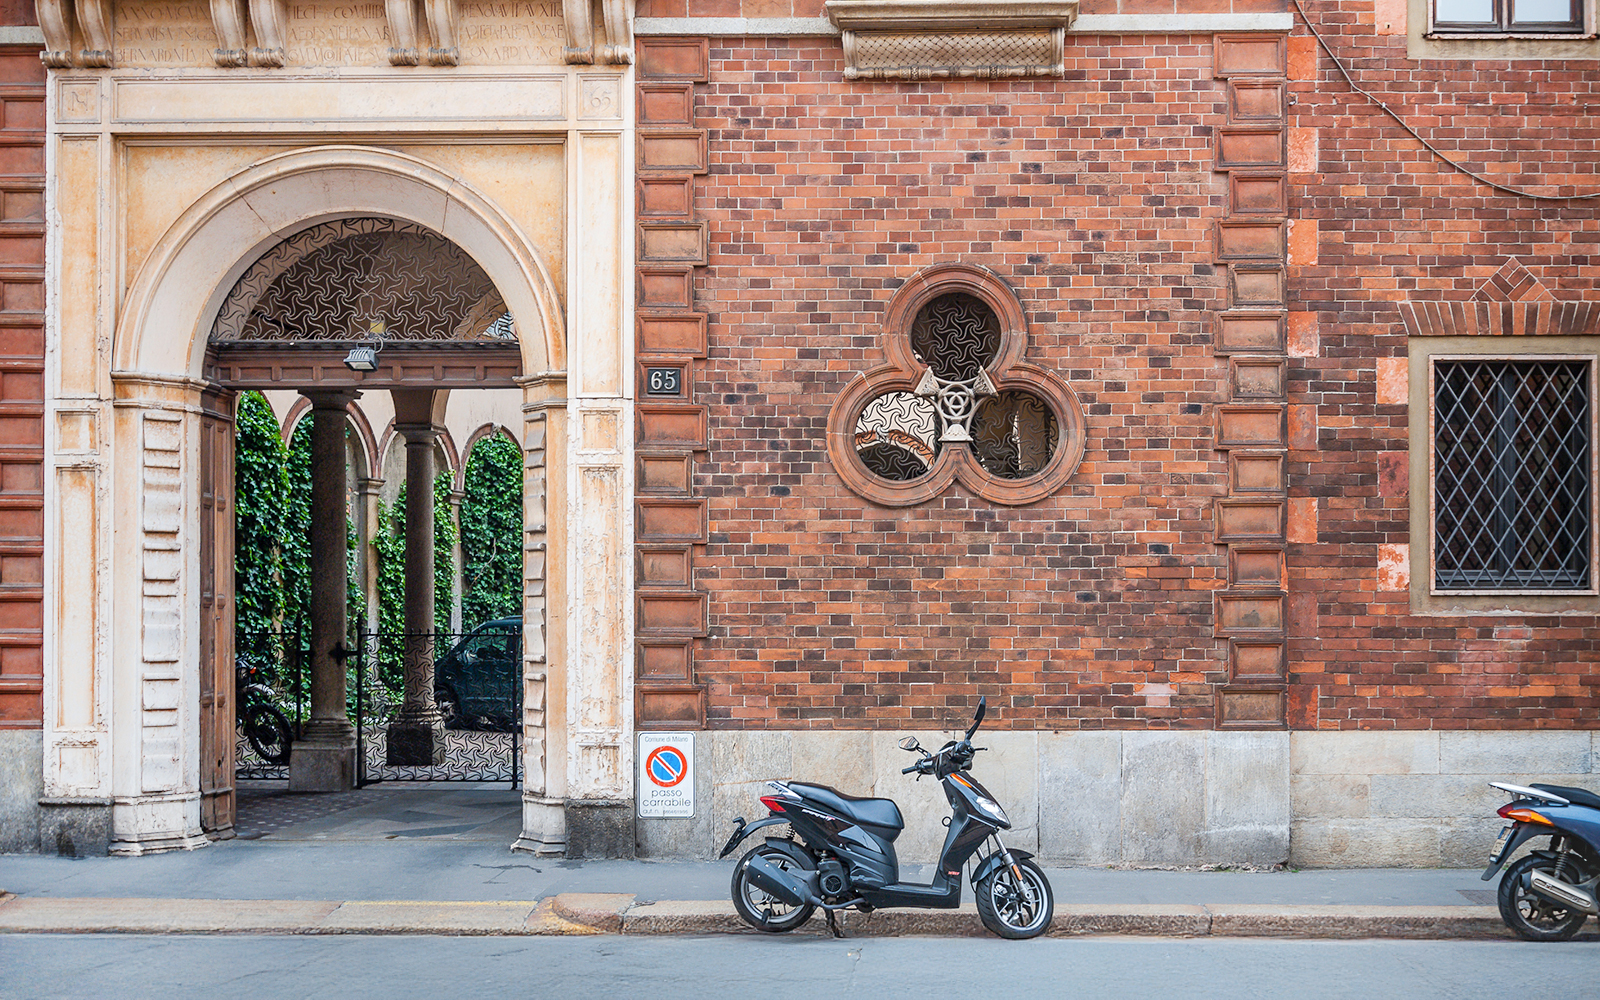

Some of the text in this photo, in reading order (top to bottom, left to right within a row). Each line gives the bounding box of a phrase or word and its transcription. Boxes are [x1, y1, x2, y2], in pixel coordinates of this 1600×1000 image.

[650, 371, 677, 390] 65
[644, 735, 688, 743] Comune di Milano
[651, 789, 682, 798] passo
[642, 798, 691, 807] carrabile
